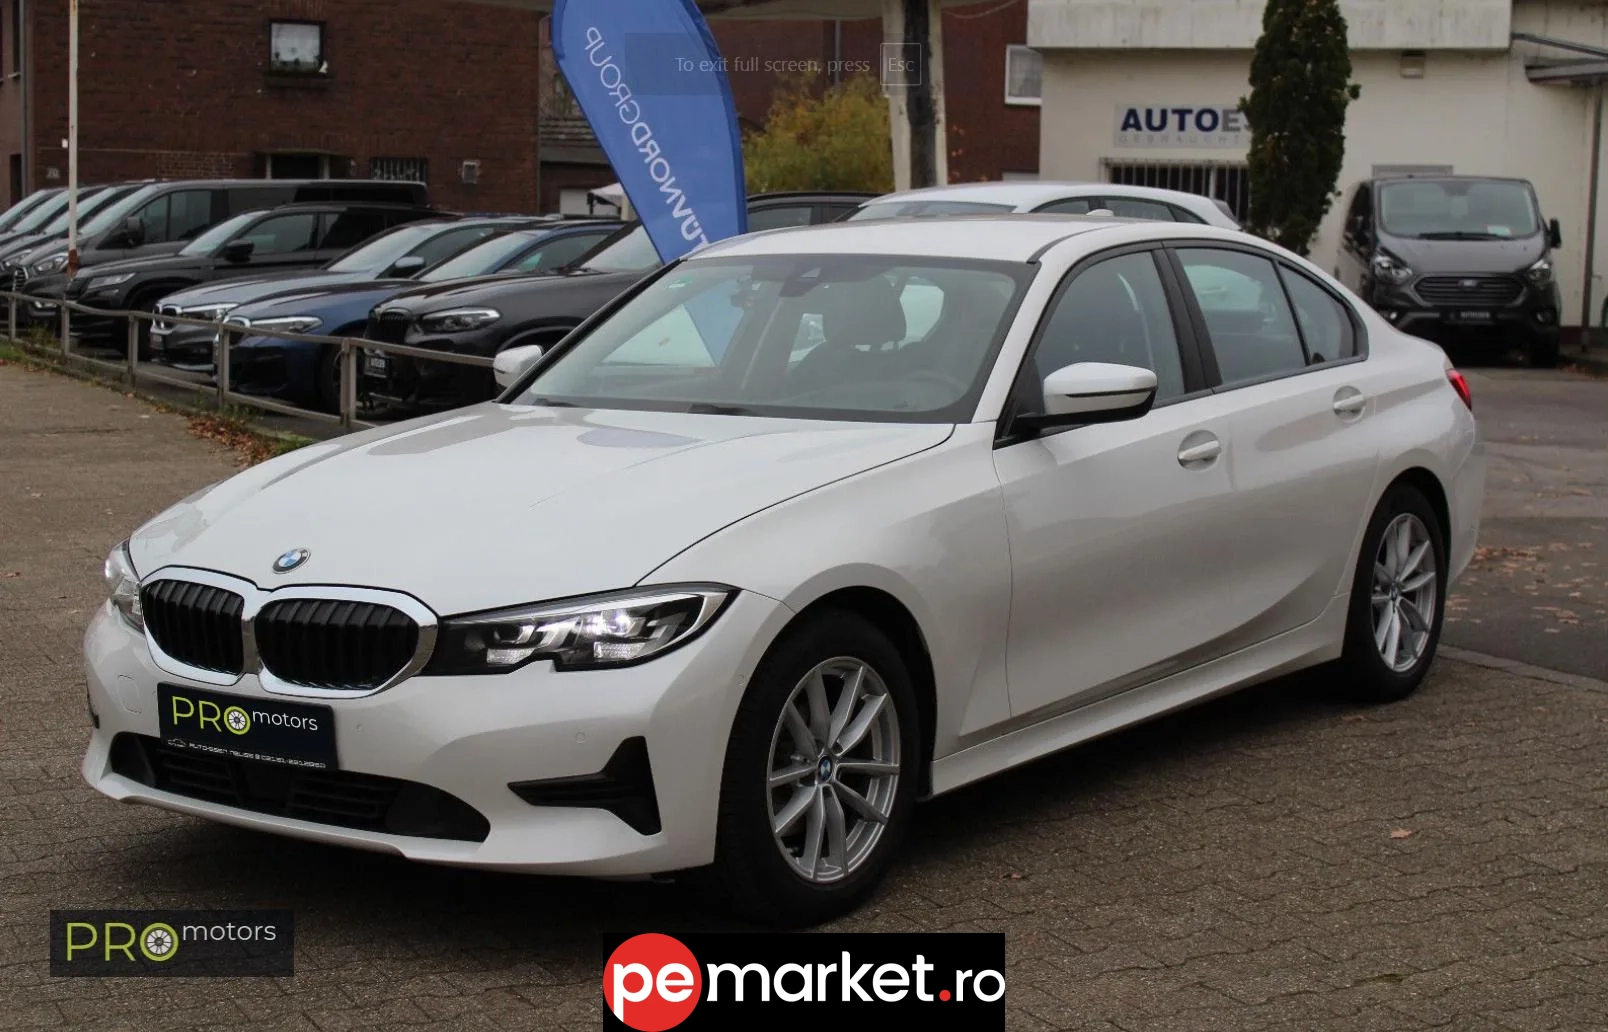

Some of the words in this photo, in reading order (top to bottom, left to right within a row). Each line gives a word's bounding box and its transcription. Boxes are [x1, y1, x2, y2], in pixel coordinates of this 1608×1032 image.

[1120, 108, 1250, 132] AUTOE
[172, 695, 251, 736] PRO
[252, 710, 318, 731] motors
